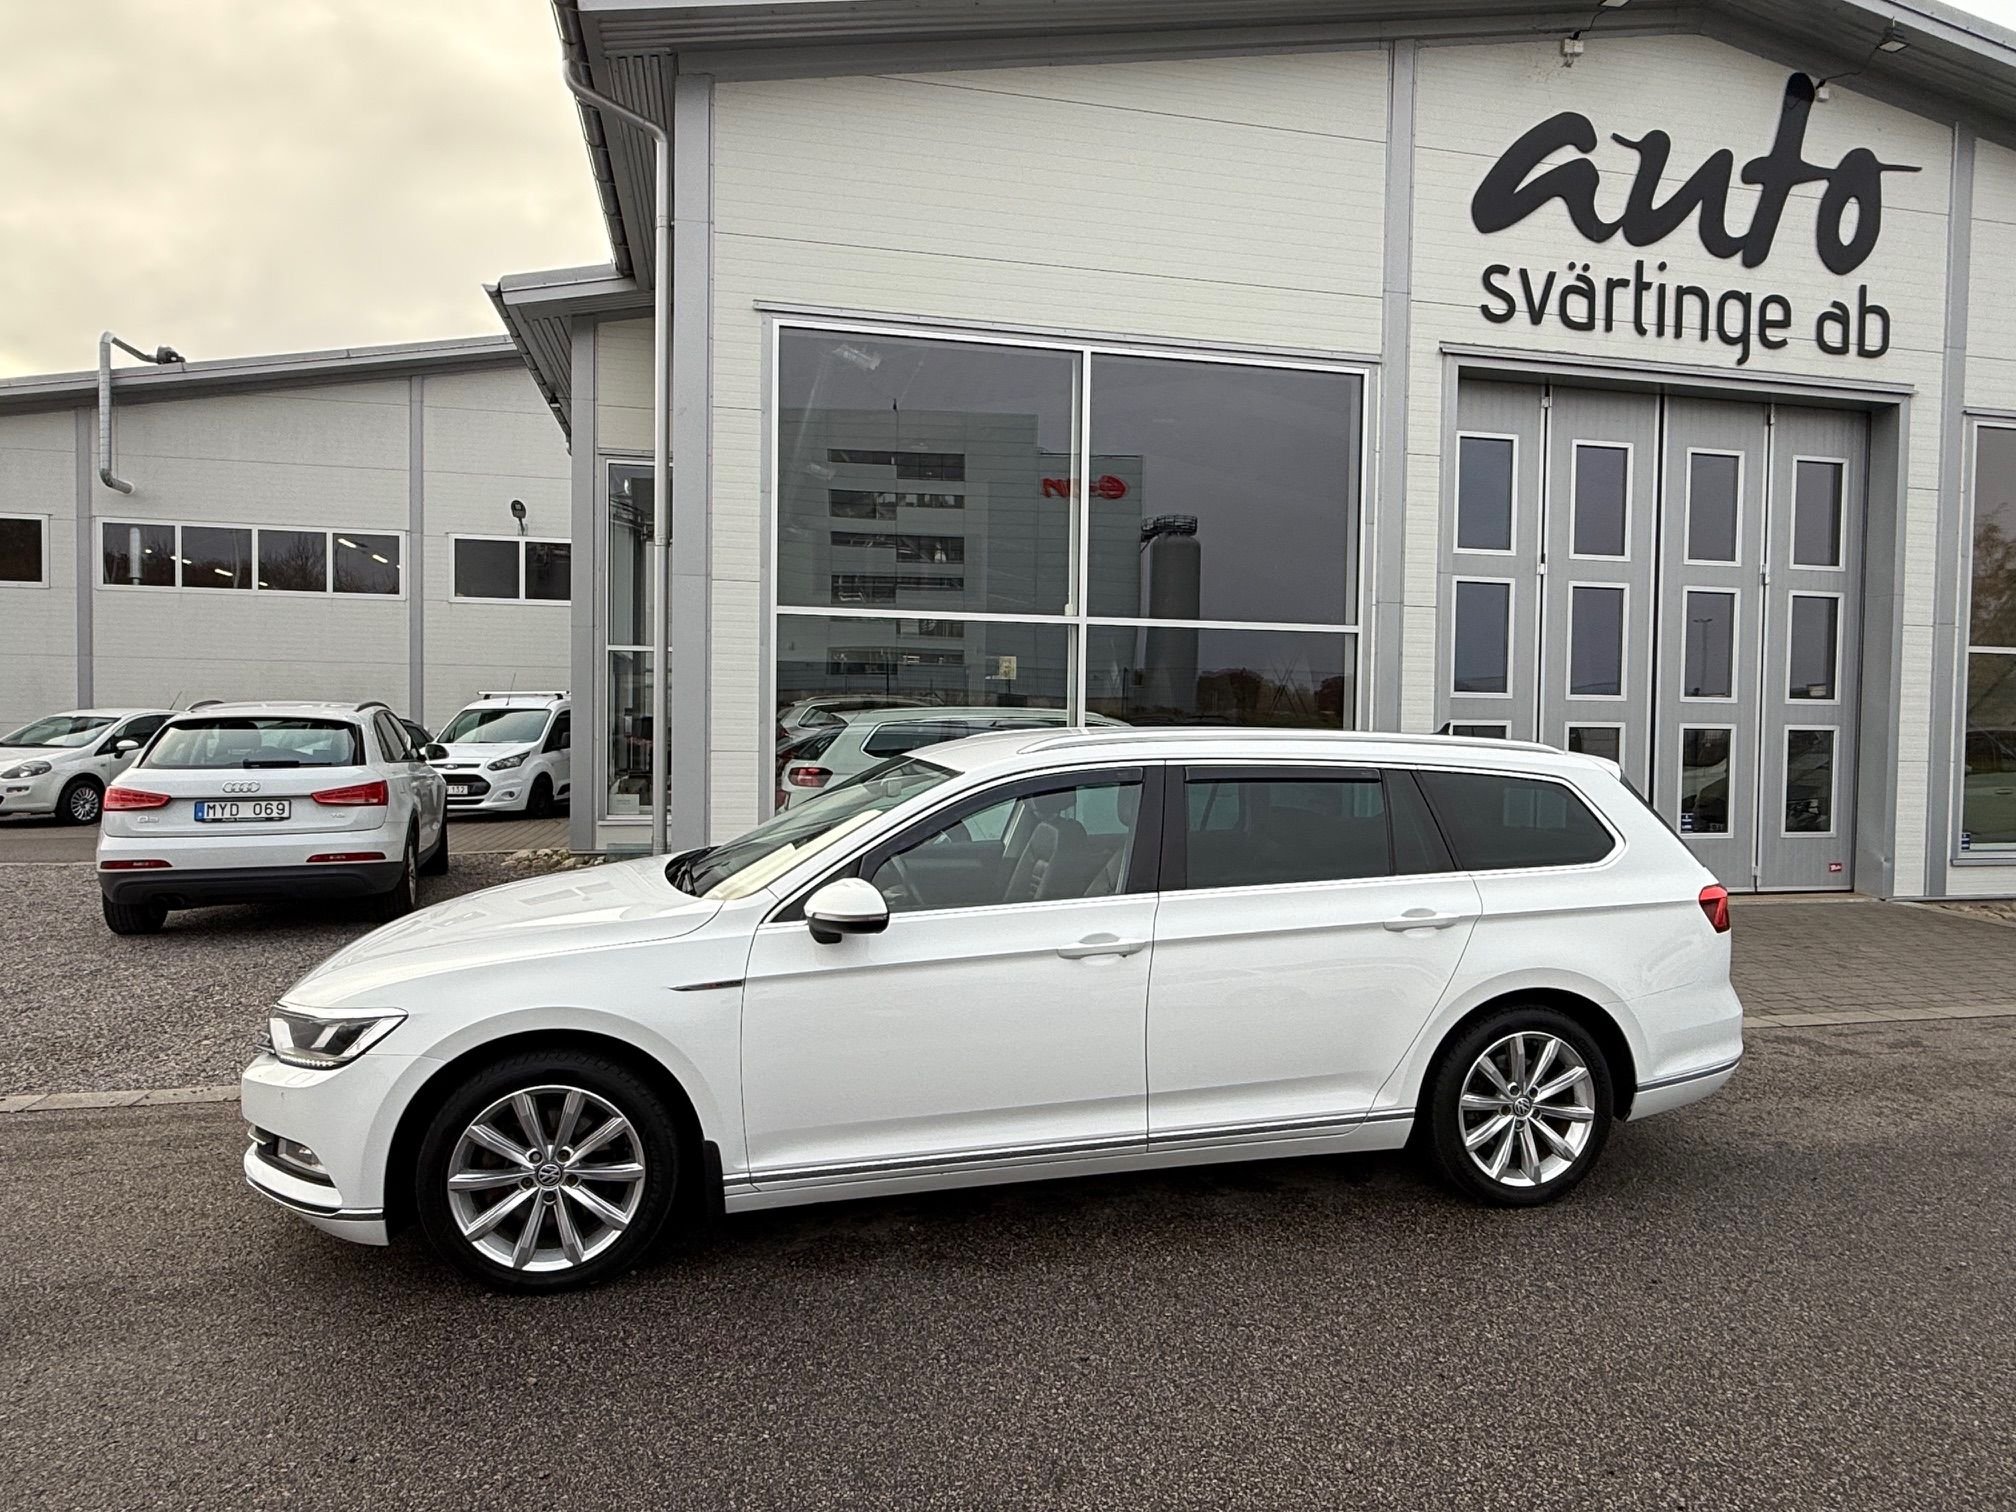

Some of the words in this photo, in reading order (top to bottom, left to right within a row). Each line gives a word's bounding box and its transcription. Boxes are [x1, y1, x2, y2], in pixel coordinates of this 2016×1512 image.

[1471, 72, 1922, 275] auto
[1480, 260, 1792, 366] svärtinge
[1815, 284, 1891, 359] ab
[206, 803, 240, 817] MYD
[252, 802, 286, 816] 069
